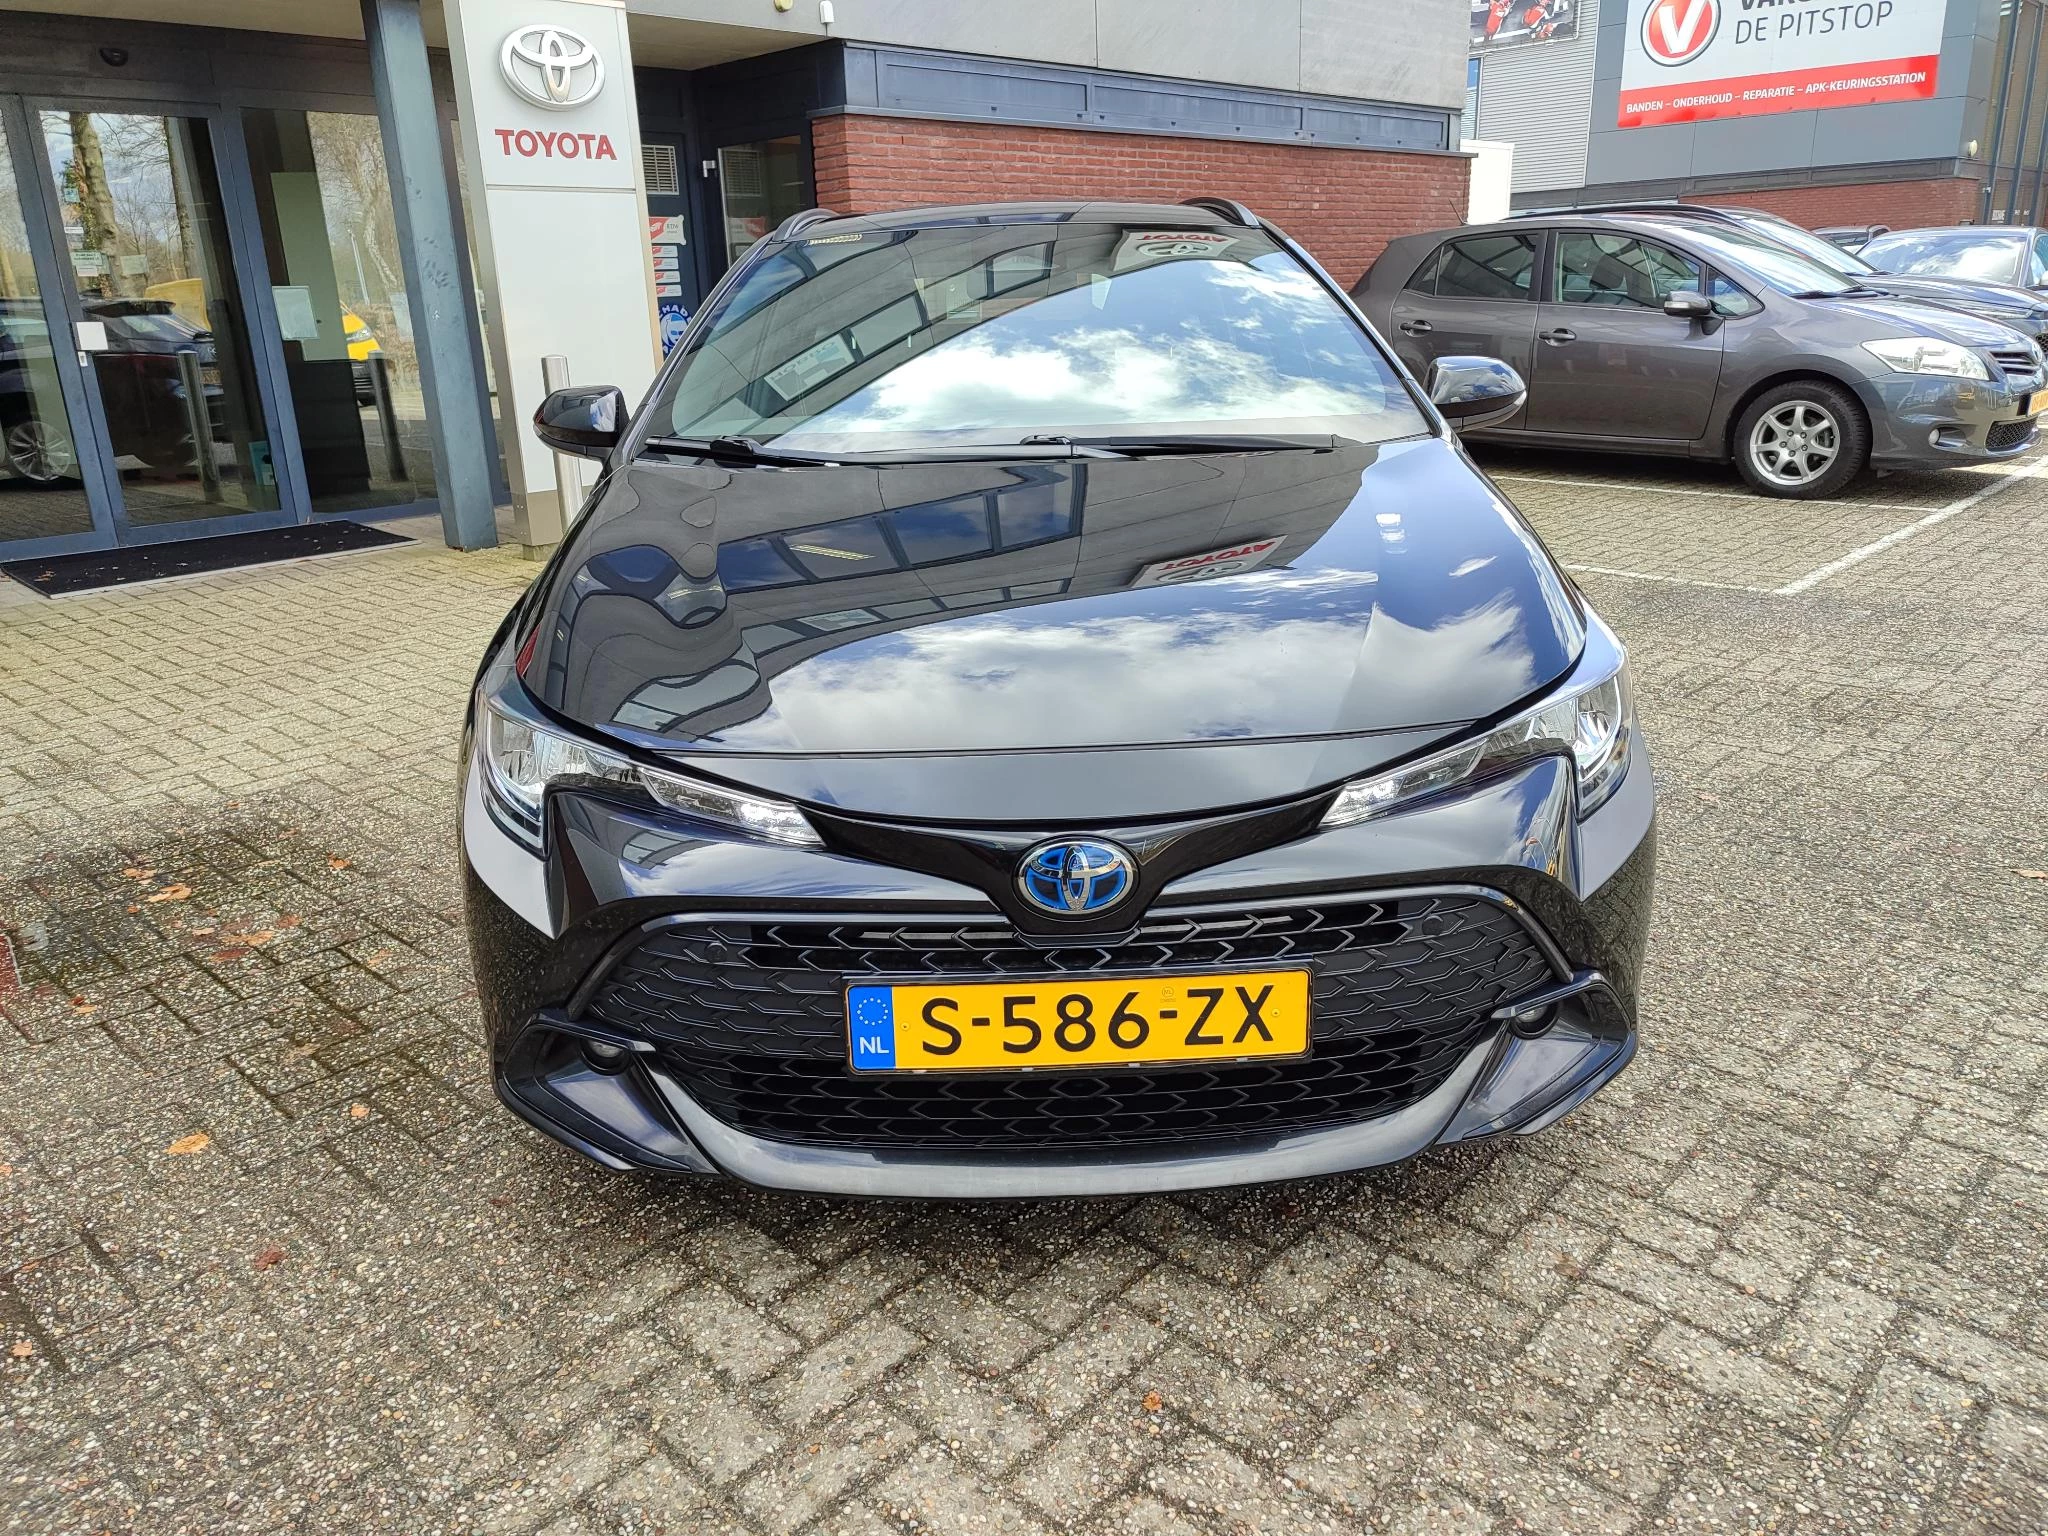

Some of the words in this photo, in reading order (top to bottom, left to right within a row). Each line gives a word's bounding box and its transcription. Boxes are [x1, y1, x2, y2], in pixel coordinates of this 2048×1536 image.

[1735, 17, 1768, 44] DE
[1779, 1, 1892, 38] PITSTOP
[1626, 101, 1663, 113] BANDEN
[1672, 93, 1733, 108] ONDERHOUD
[1742, 86, 1795, 100] REPARATIE
[1805, 72, 1926, 94] APK-KEURINGSSTATION
[494, 129, 618, 160] TOYOTA
[921, 984, 1275, 1056] S-586-ZX
[859, 1036, 889, 1054] NL
